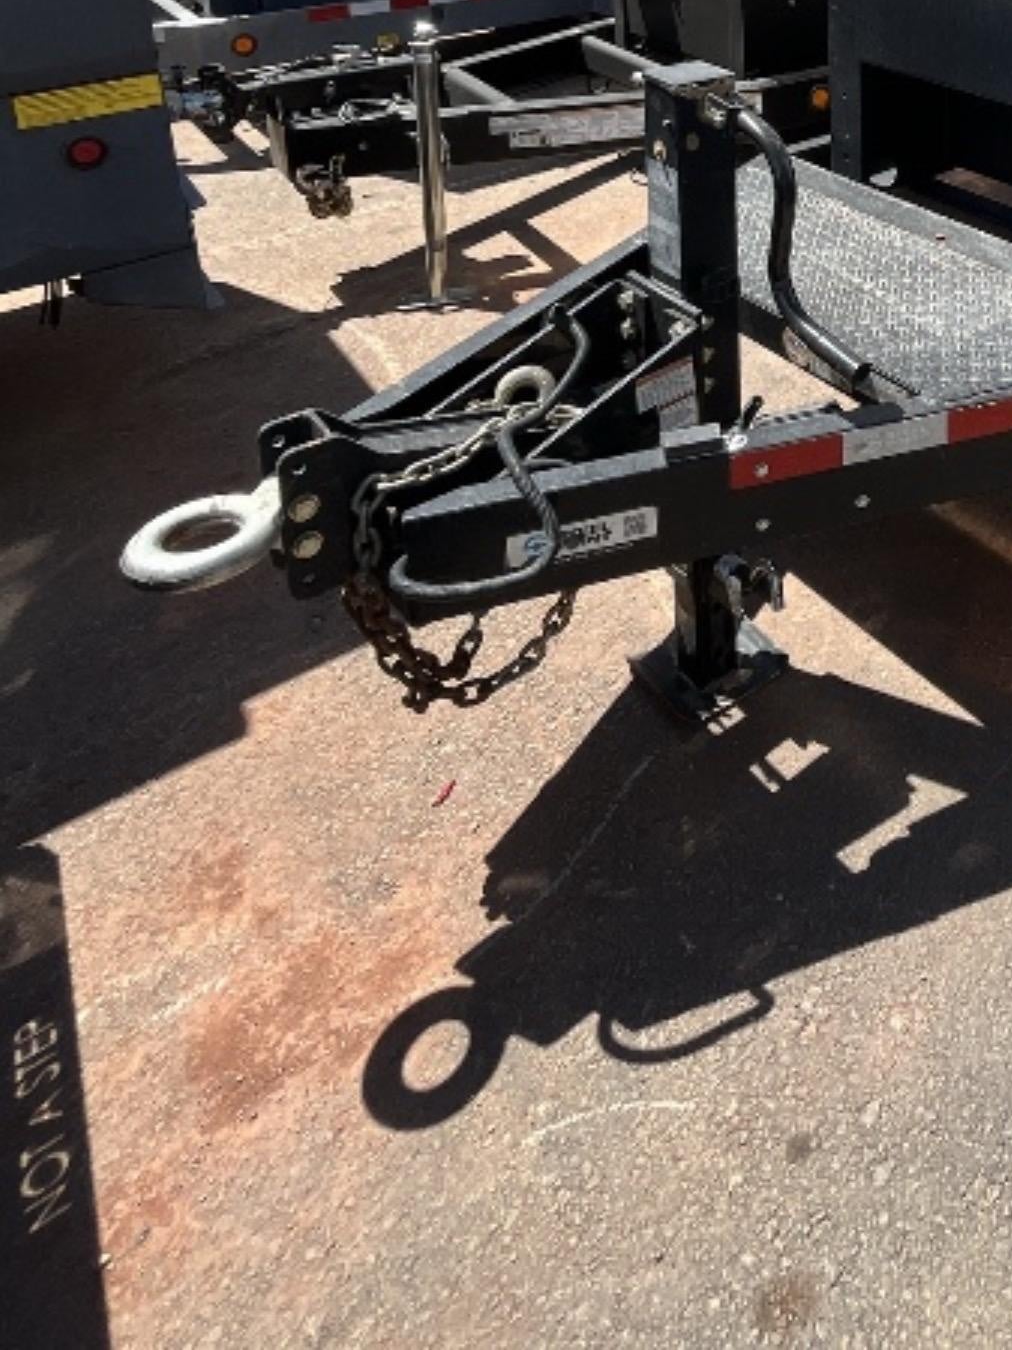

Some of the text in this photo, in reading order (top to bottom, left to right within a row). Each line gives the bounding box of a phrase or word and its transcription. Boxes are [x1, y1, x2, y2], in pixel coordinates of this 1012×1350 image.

[14, 1018, 72, 1235] NOT A STEP
